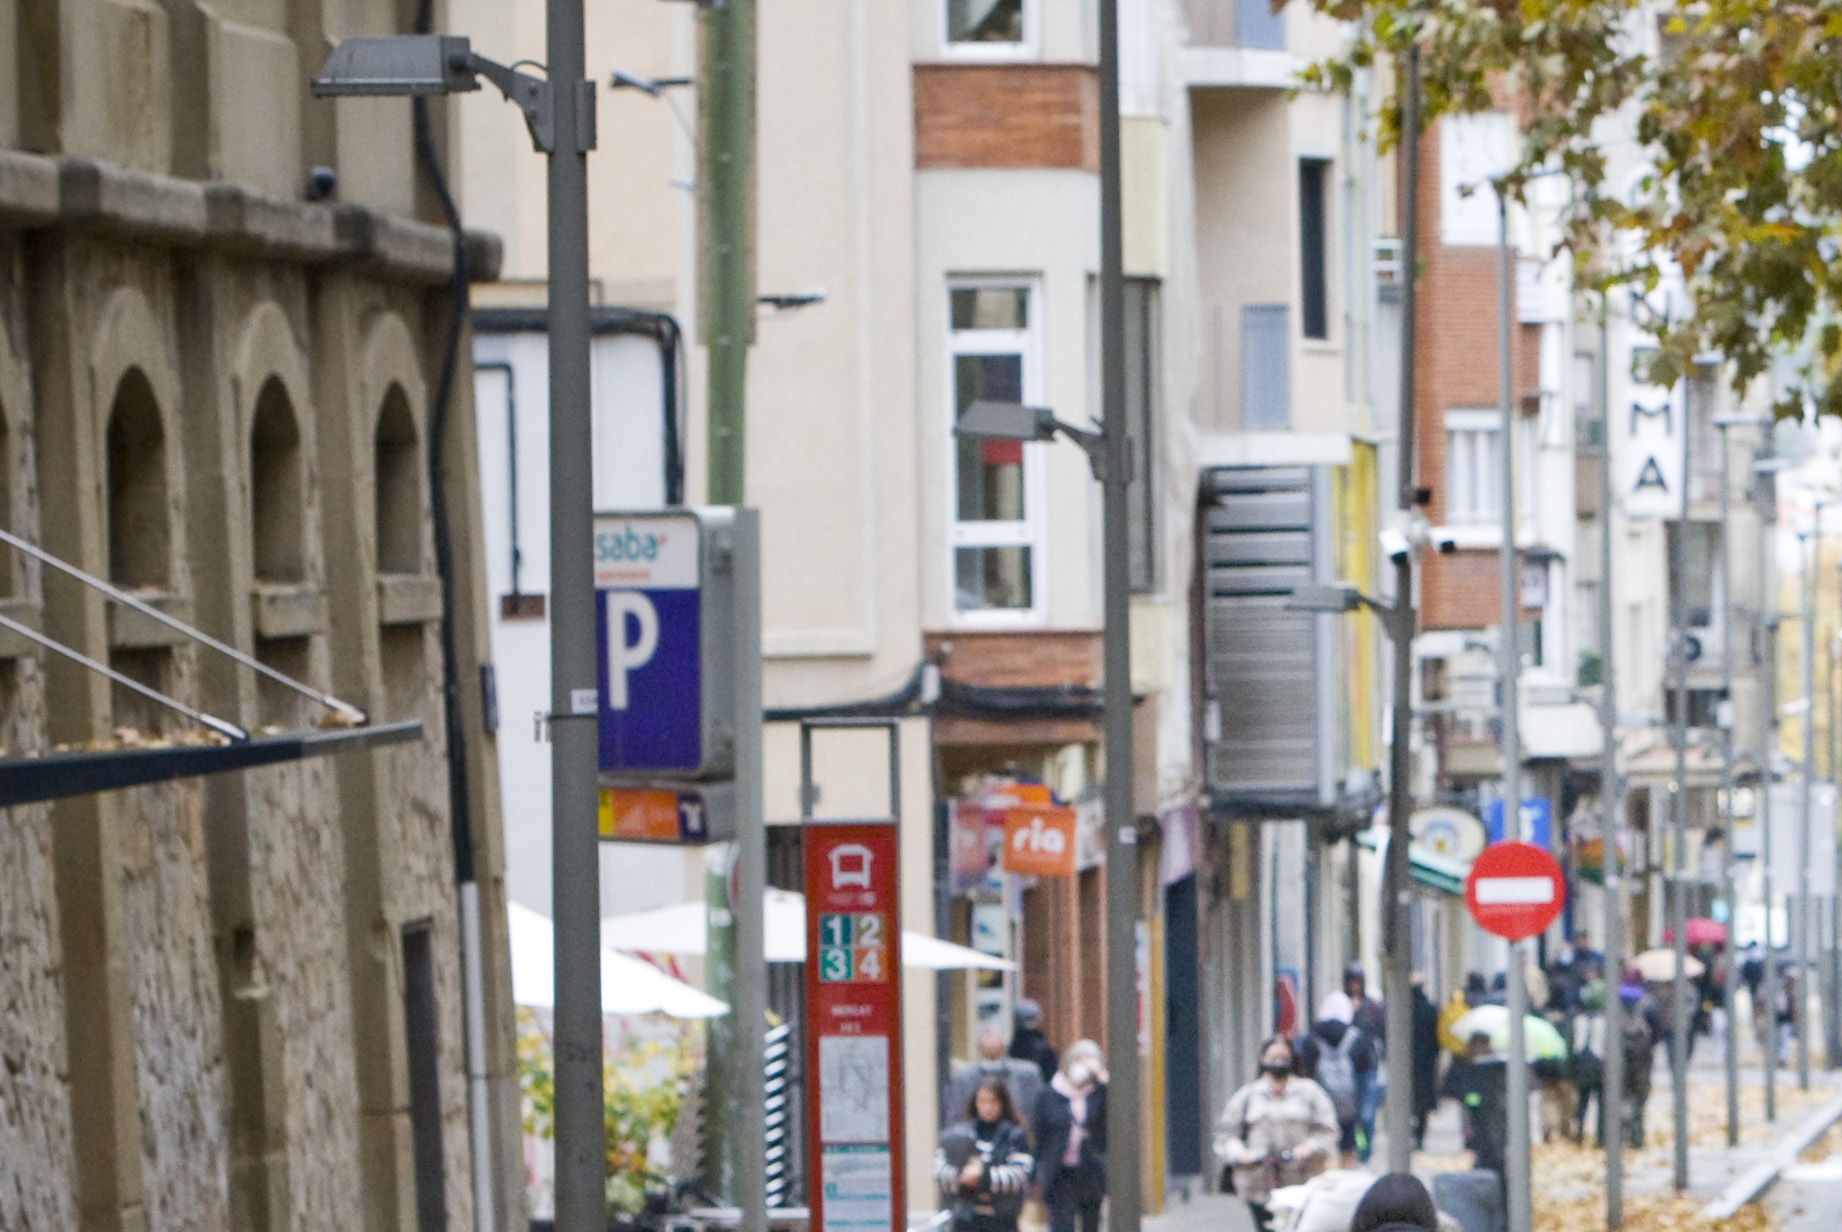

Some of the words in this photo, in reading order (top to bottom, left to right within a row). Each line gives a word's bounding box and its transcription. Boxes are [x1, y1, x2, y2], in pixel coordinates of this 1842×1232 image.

[596, 523, 658, 562] saba
[605, 590, 660, 711] P
[1012, 816, 1066, 854] ria
[826, 915, 842, 946] 1
[859, 914, 881, 947] 2
[825, 950, 847, 980] 3
[859, 951, 881, 981] 4
